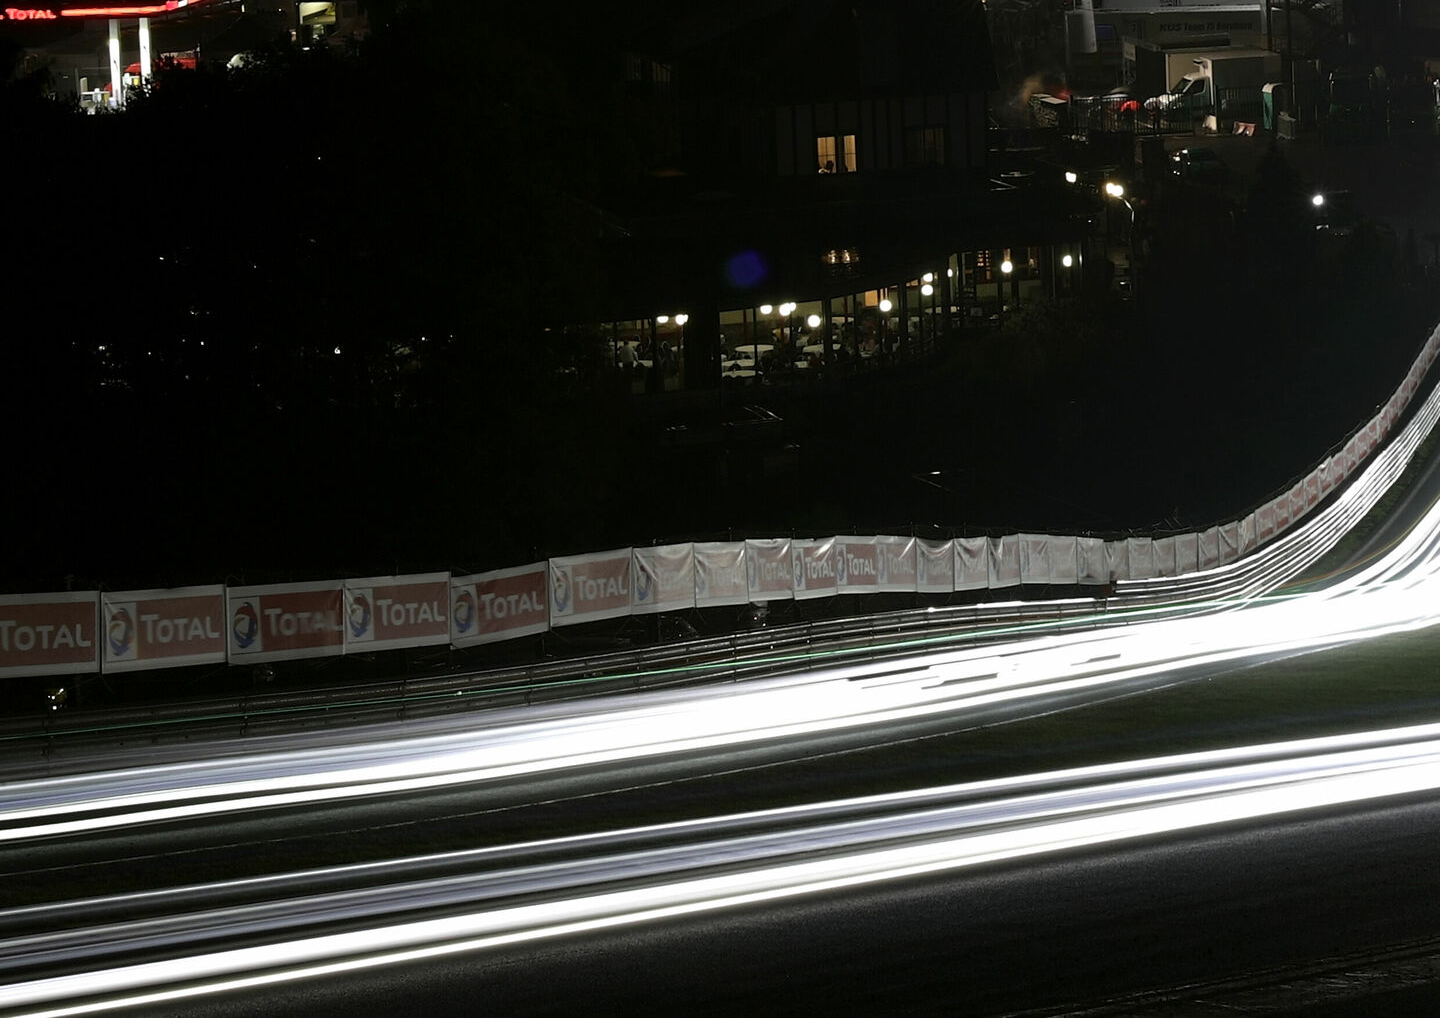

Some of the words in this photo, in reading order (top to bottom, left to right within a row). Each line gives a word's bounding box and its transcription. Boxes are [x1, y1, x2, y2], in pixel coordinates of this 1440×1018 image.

[5, 8, 57, 20] TOTAL
[805, 557, 835, 580] TOTAL
[847, 556, 876, 576] TOTAL
[575, 575, 628, 601] TOTAL
[377, 598, 446, 626] TOTAL
[481, 590, 545, 620] TOTAL
[0, 619, 91, 651] TOTAL
[140, 613, 220, 644] TOTAL
[264, 607, 343, 638] TOTAL
